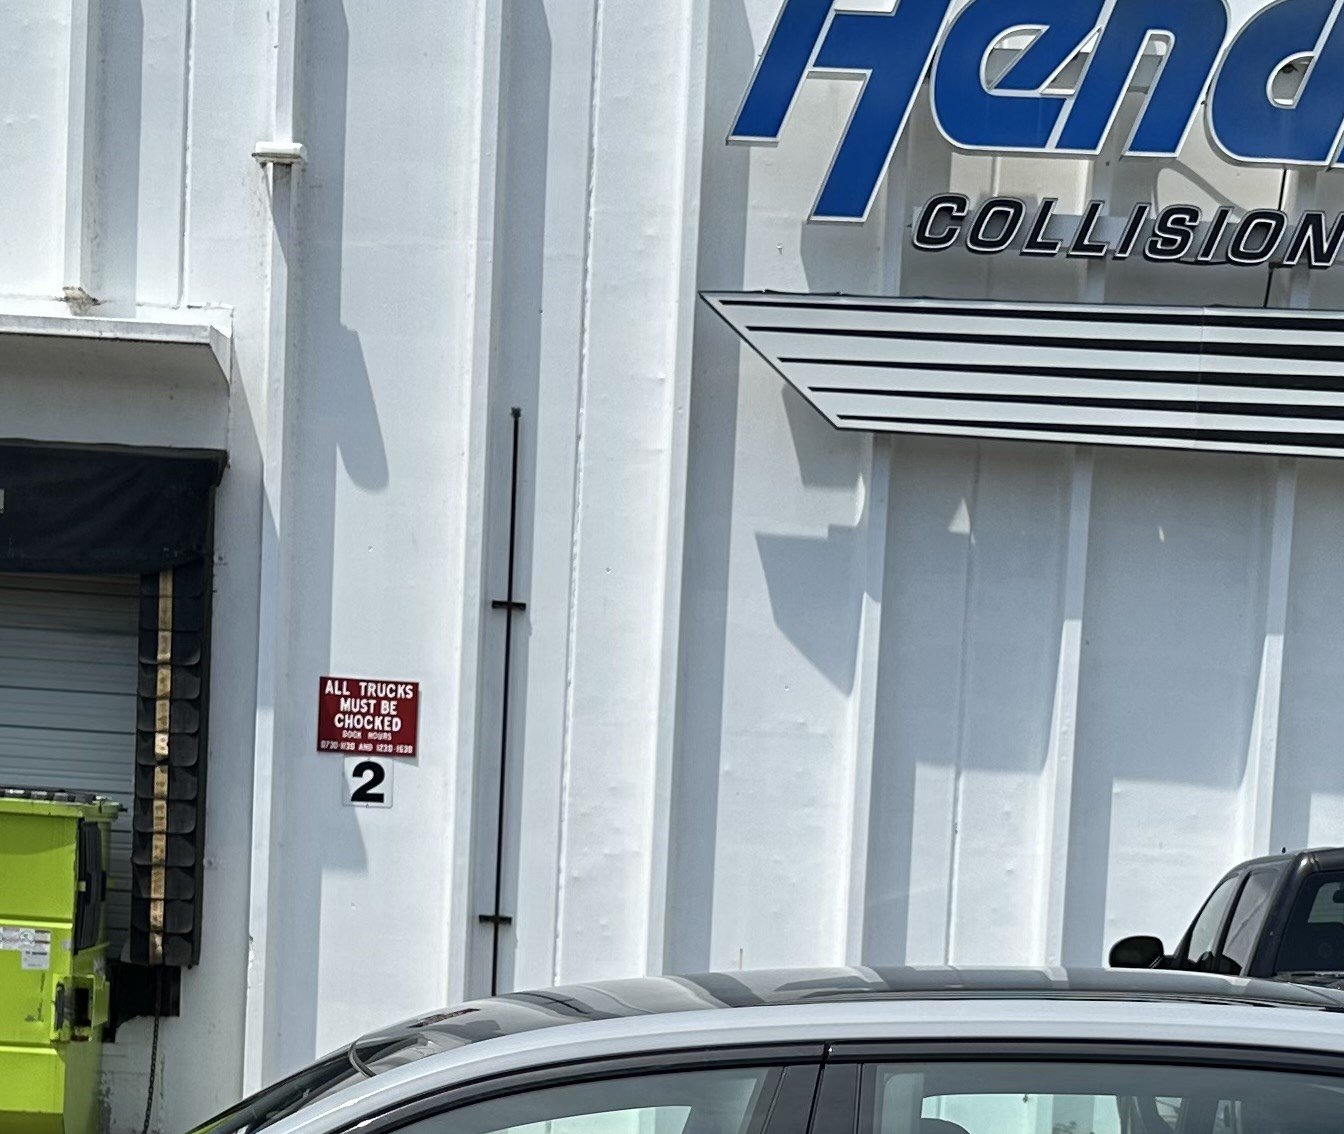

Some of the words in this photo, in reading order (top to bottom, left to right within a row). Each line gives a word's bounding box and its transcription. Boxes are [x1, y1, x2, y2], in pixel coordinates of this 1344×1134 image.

[325, 680, 351, 696] ALL
[358, 682, 414, 699] TRUCKS
[340, 697, 377, 714] MUST
[380, 700, 398, 715] BE
[334, 713, 402, 732] CHOCKED
[367, 732, 392, 741] HOURS
[358, 743, 374, 752] AND
[350, 760, 386, 803] 2
